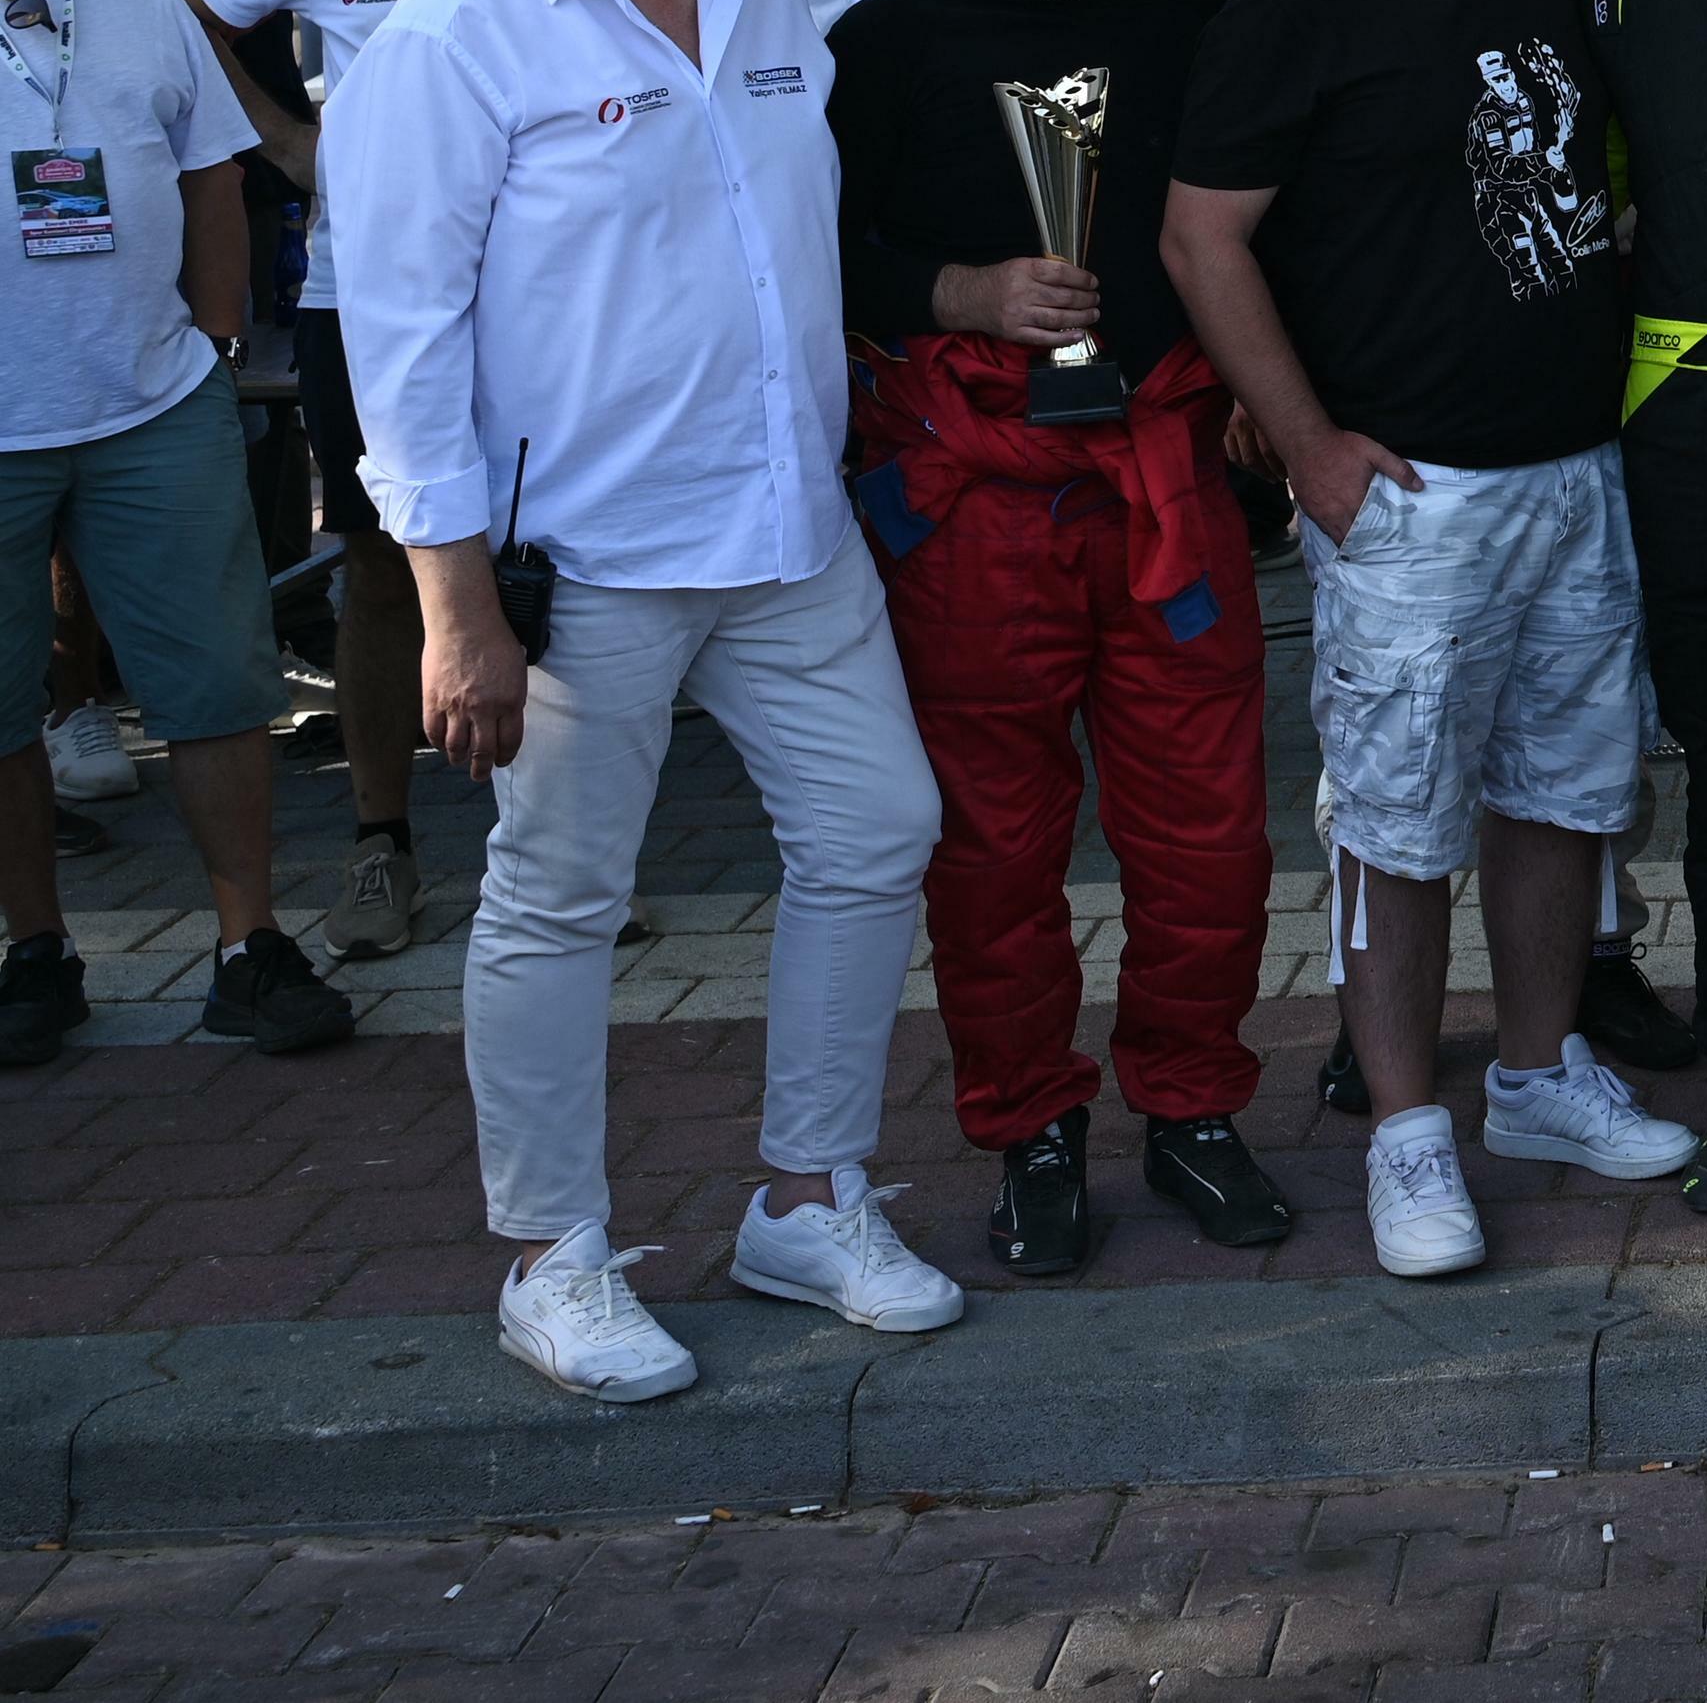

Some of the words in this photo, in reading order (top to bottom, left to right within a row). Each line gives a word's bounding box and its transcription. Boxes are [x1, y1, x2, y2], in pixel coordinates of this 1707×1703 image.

[756, 68, 799, 81] BOSSEK
[624, 88, 669, 105] TOSFED
[749, 87, 775, 99] Yalçın
[777, 85, 807, 95] YILMAZ
[1571, 244, 1593, 258] Colin
[1636, 330, 1681, 350] sparco
